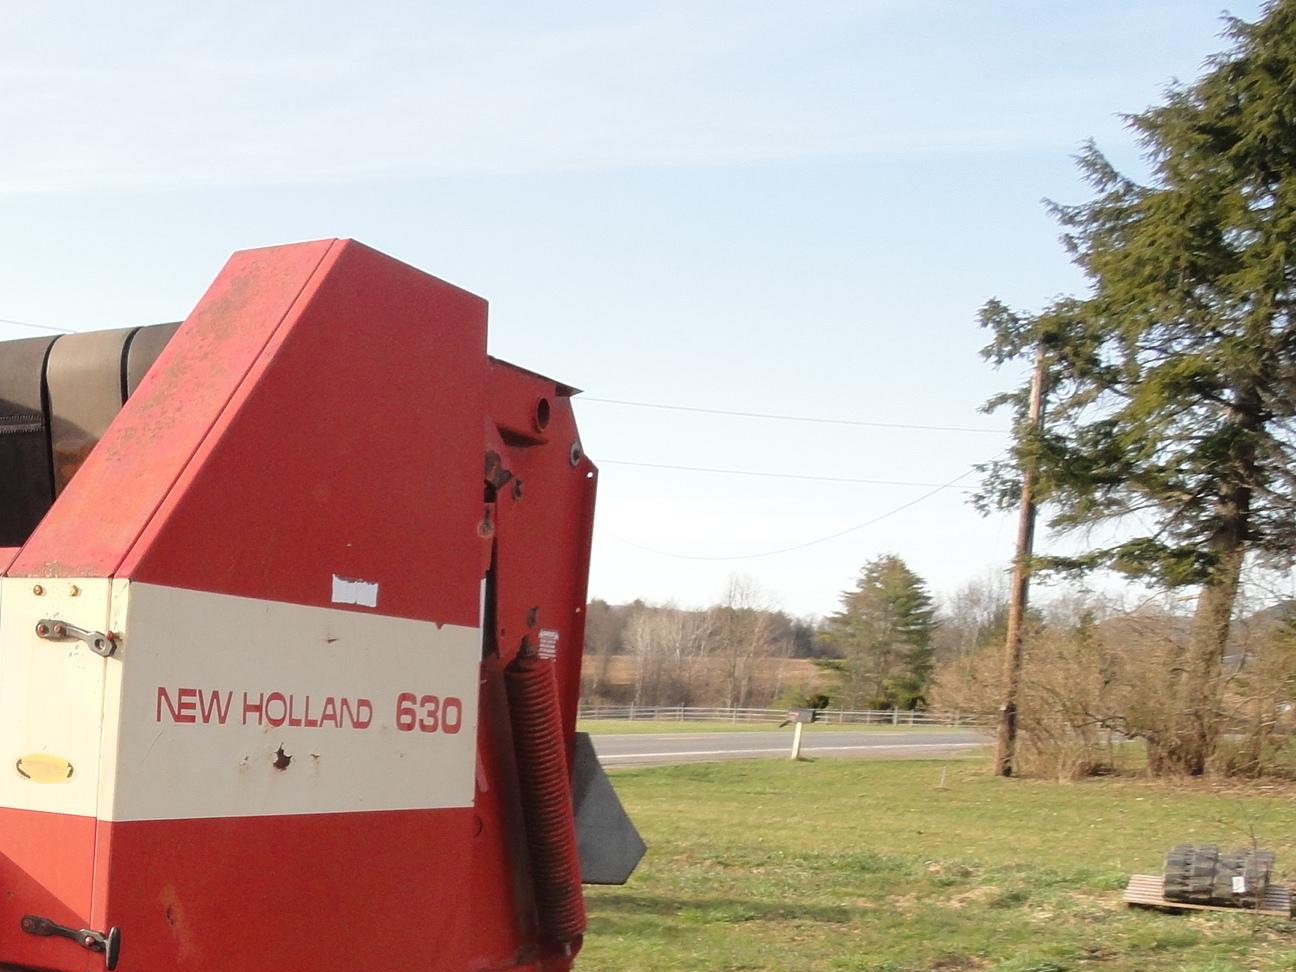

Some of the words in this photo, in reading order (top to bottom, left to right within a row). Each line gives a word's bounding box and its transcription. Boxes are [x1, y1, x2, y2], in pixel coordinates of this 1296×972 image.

[156, 687, 233, 725] NEW
[243, 692, 373, 729] HOLLAND
[396, 692, 462, 734] 630
